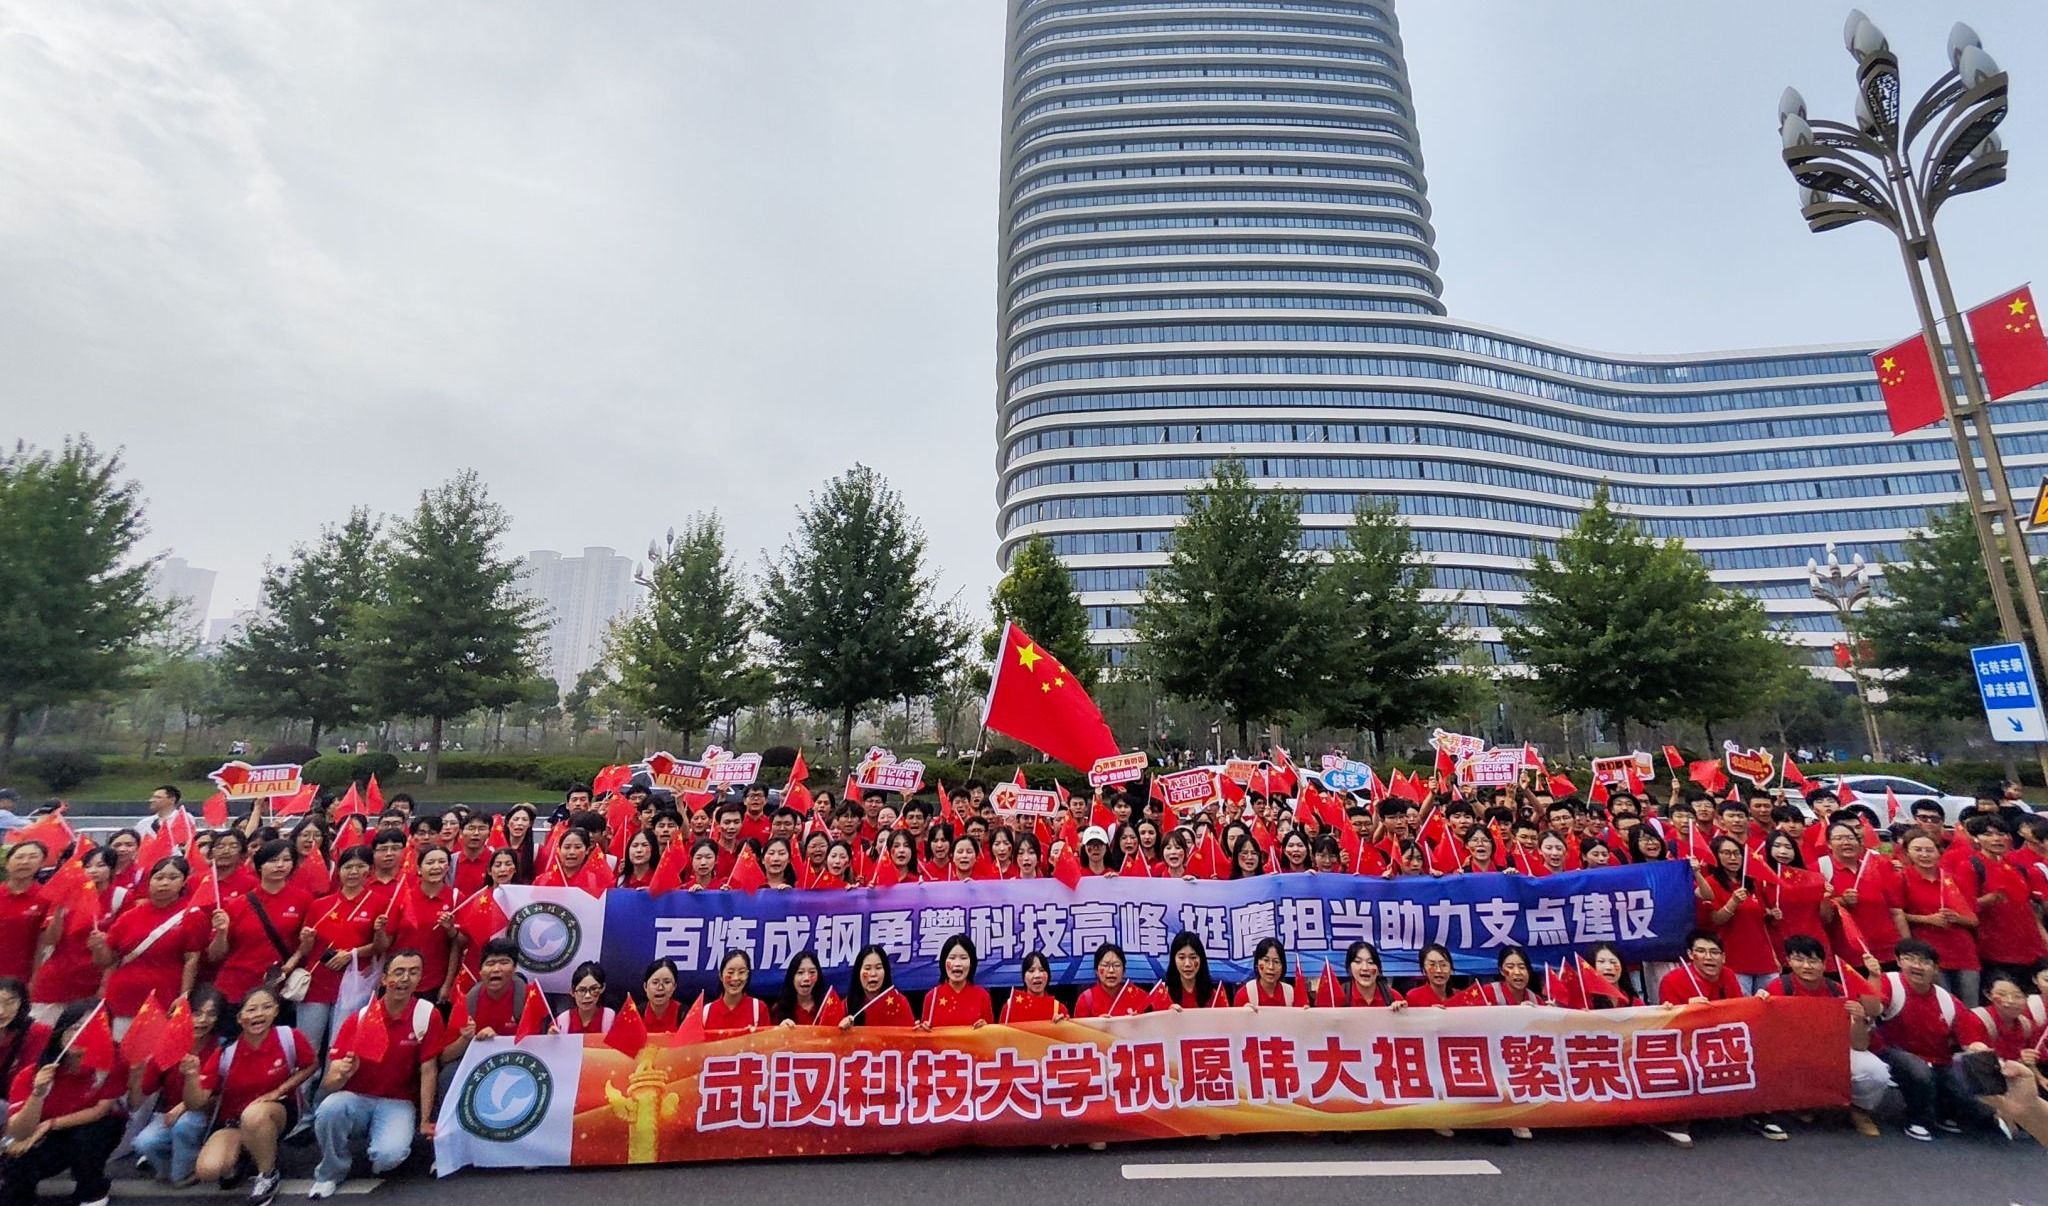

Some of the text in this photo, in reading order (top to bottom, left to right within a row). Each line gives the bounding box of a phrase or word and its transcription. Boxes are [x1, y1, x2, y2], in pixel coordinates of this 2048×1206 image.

[1978, 658, 2024, 675] 右转车辆
[1984, 680, 2031, 698] 请走辅道
[247, 768, 290, 783] 为祖国
[668, 763, 704, 778] 为祖国
[1168, 772, 1209, 790] 不忘初心
[1332, 773, 1360, 787] 快乐
[1171, 784, 1212, 802] 牢记使命
[654, 901, 1169, 972] 百炼成钢勇攀科技高峰
[1180, 889, 1658, 960] 挺膺担当助力支点建设
[695, 1022, 1757, 1132] 武汉科技大学祝愿伟大祖国繁荣昌盛
